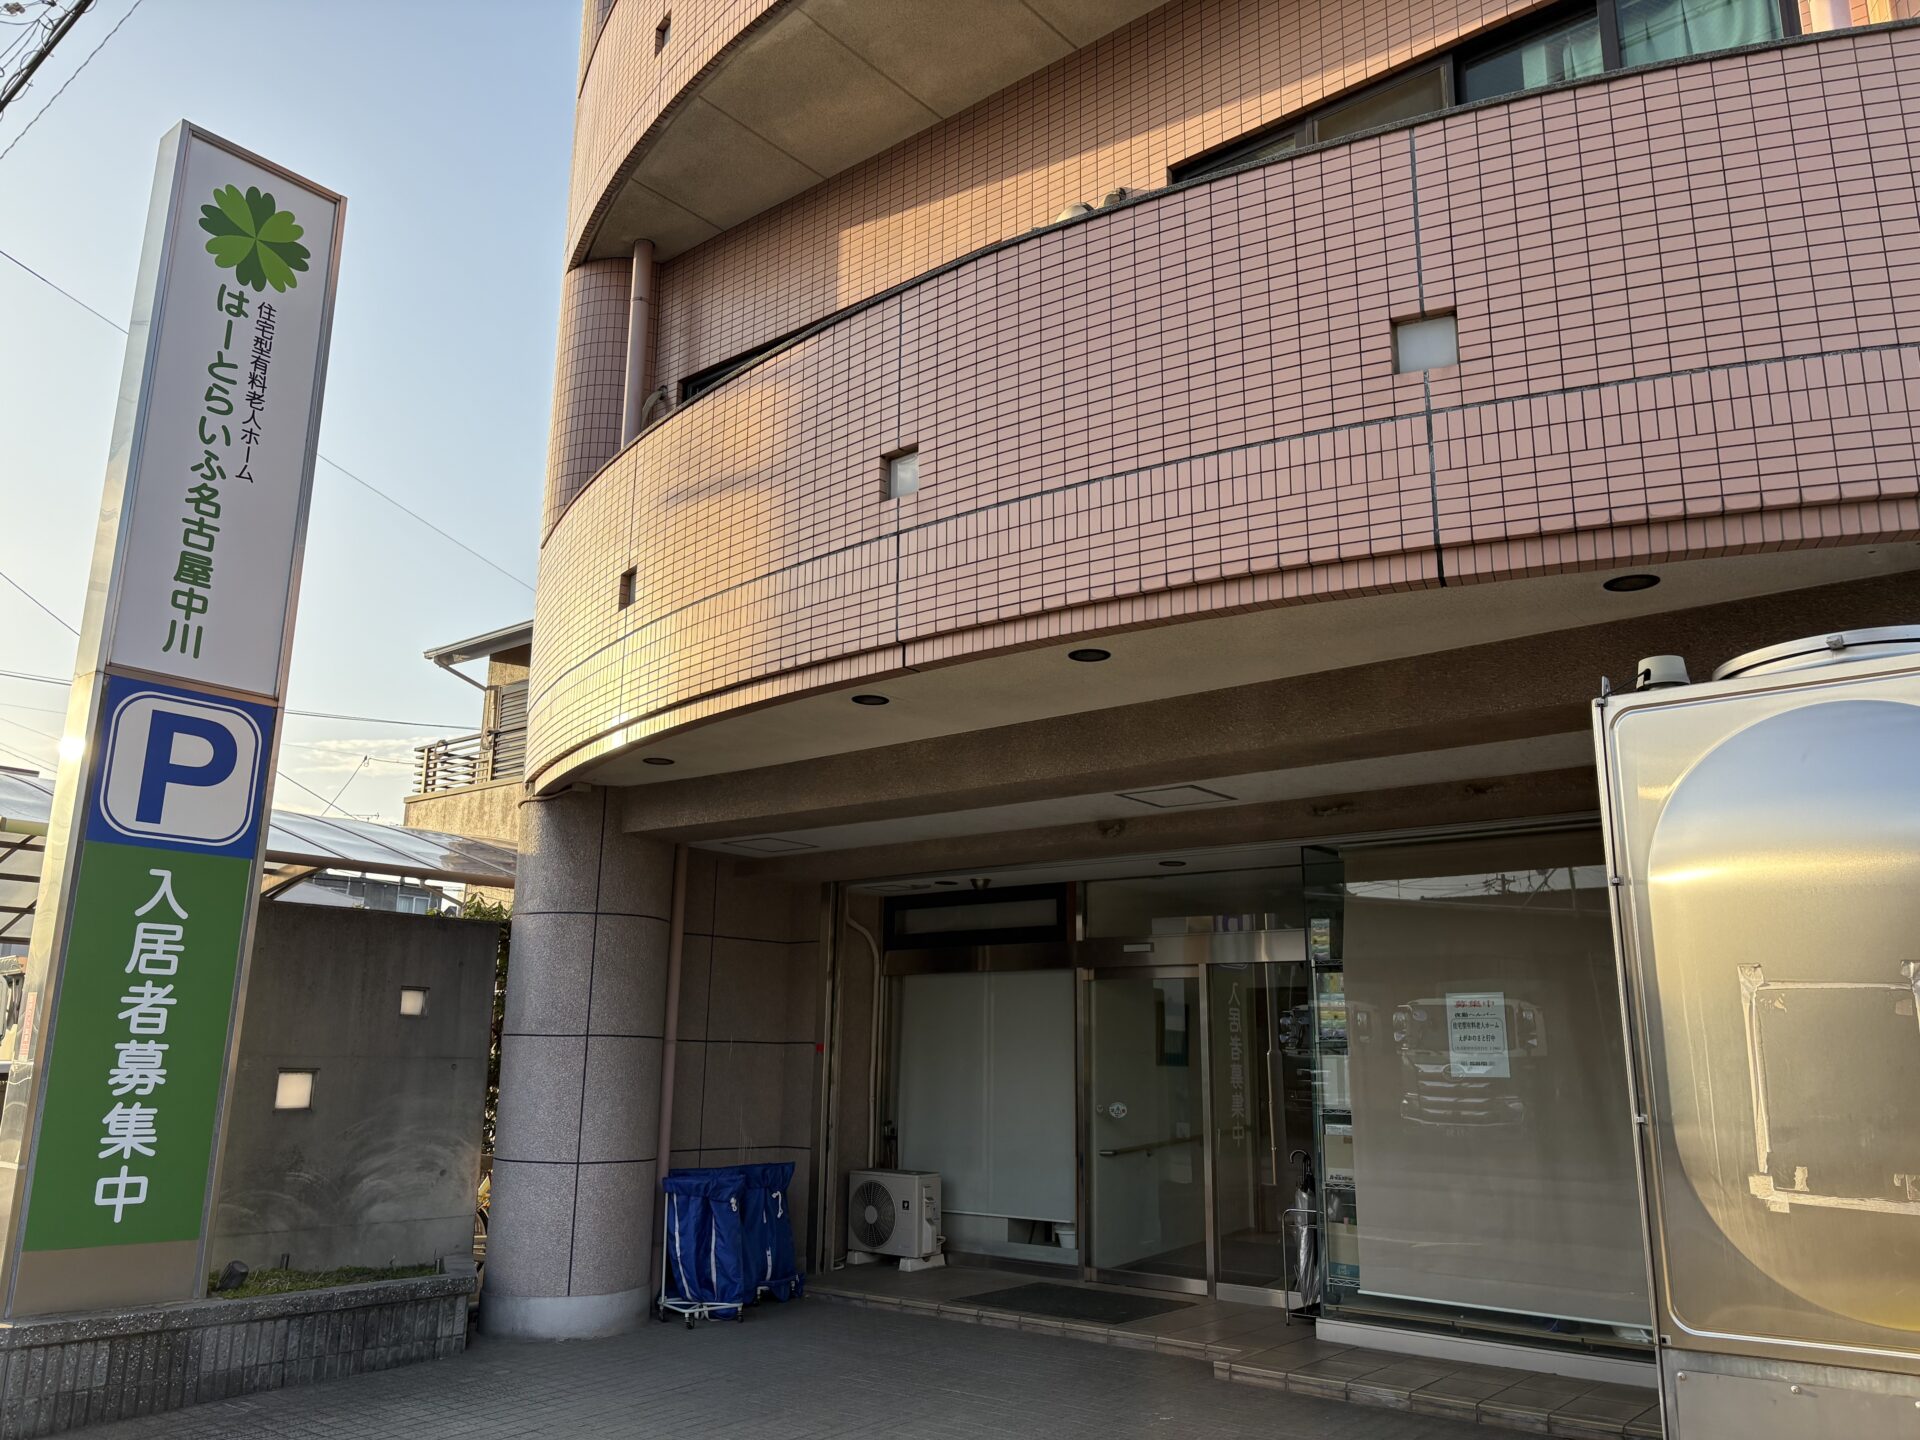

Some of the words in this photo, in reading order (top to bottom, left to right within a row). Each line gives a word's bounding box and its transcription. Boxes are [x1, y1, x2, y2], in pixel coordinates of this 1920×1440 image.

[162, 283, 250, 659] はーとらいふ名古屋中川
[235, 302, 277, 483] 住宅型有料老人ホーム
[135, 710, 238, 824] P
[94, 868, 189, 1224] 入居者募集中
